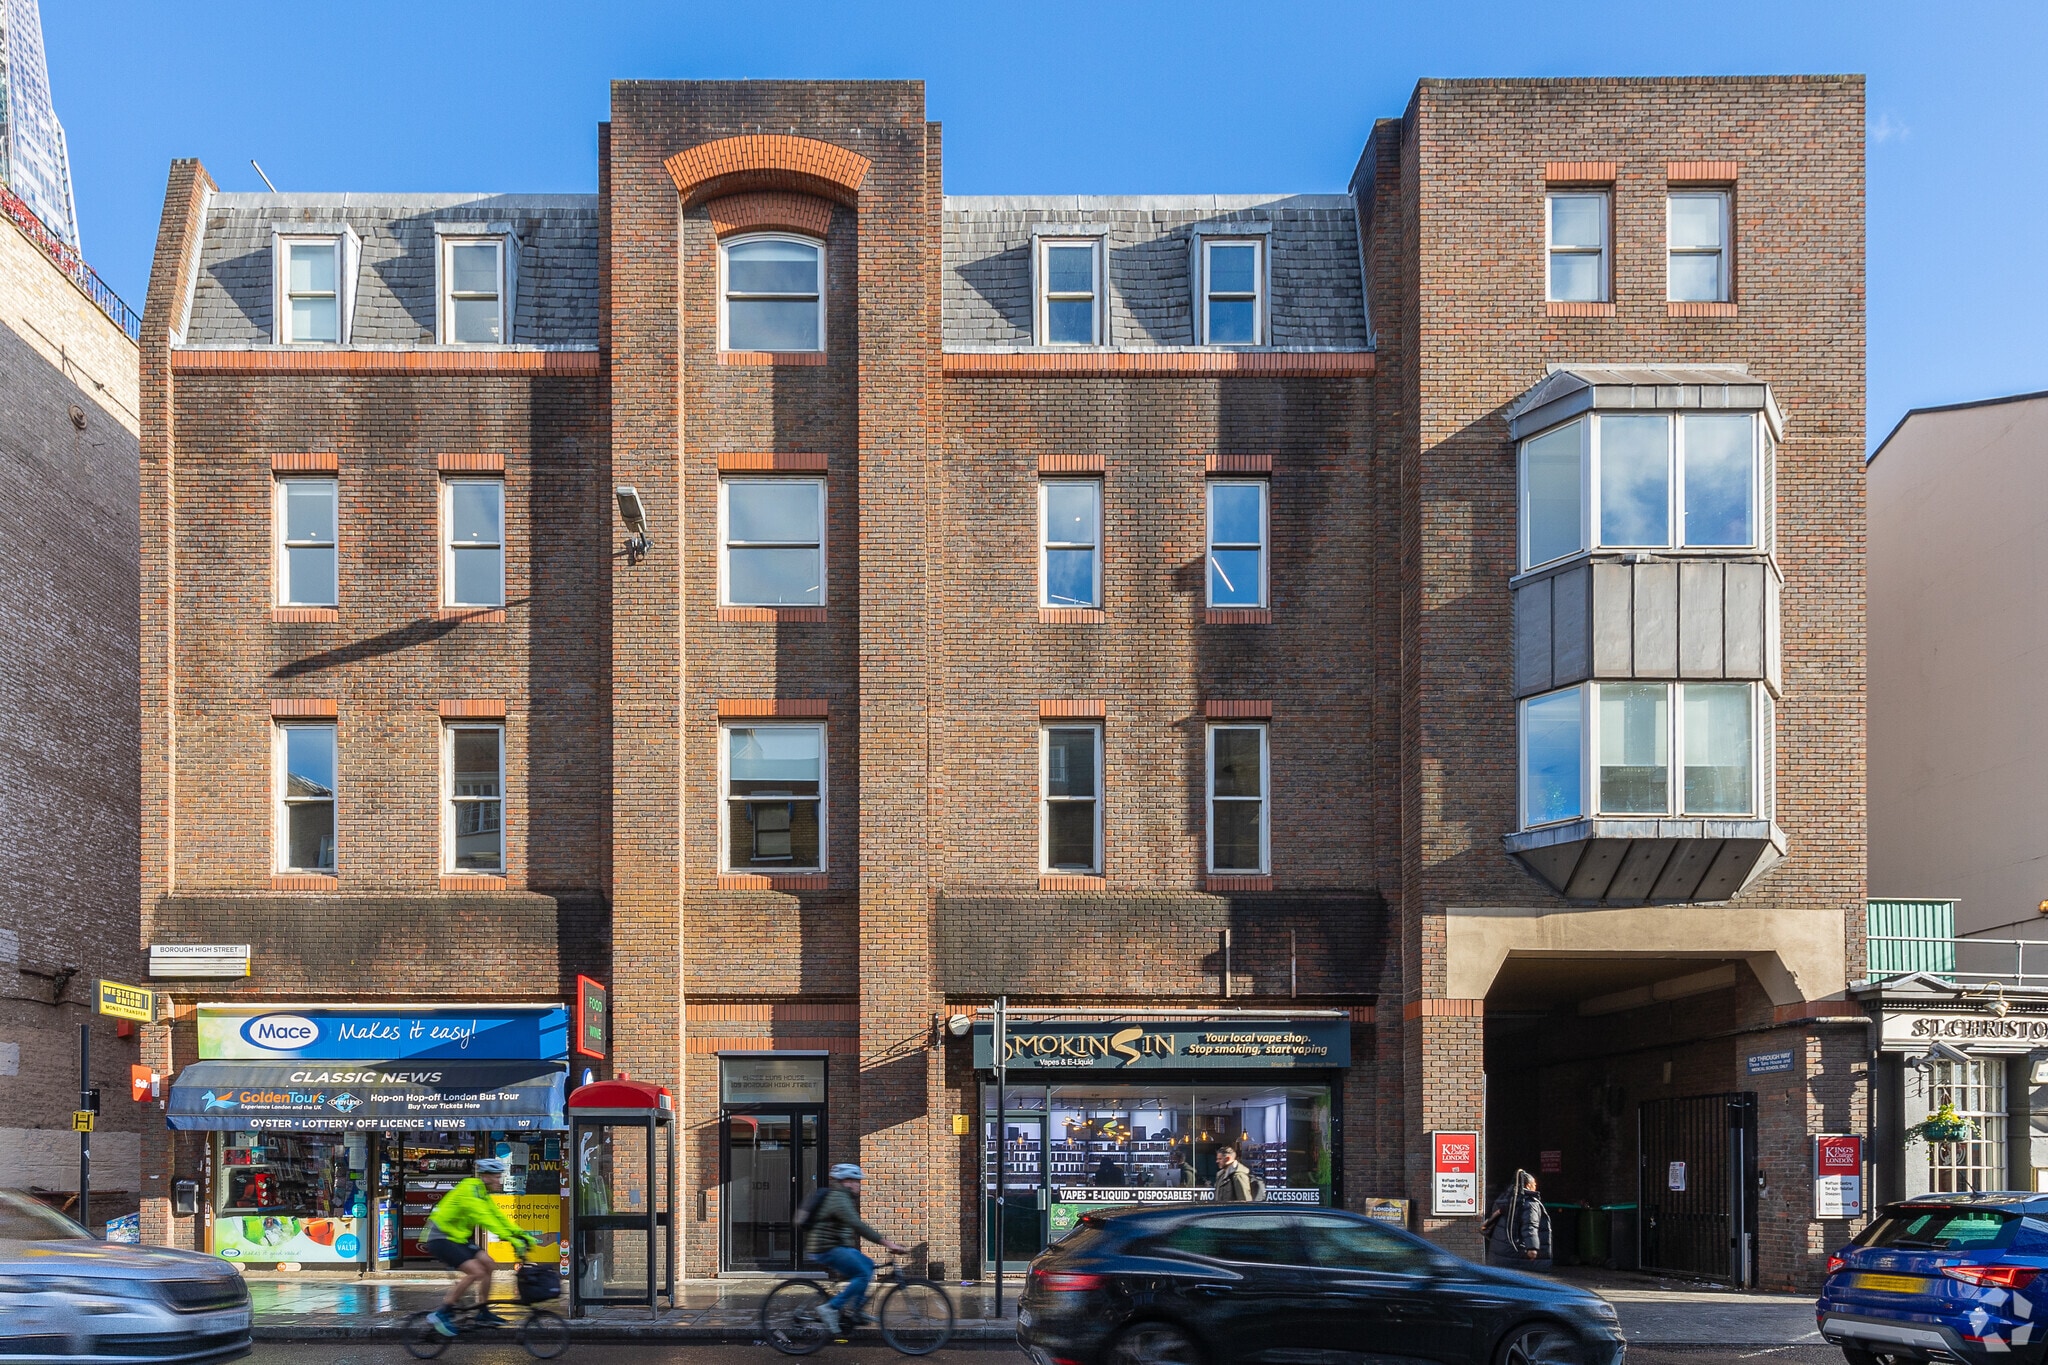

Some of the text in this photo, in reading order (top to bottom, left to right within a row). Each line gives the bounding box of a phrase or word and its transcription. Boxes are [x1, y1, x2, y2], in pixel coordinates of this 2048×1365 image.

[103, 986, 142, 1000] WESTERN
[116, 996, 142, 1008] UNION
[588, 997, 603, 1012] FOOD
[105, 1004, 147, 1017] MONEY TRANSFER
[258, 1019, 477, 1050] Mace Makes it easy!
[589, 1025, 602, 1040] WINE
[1205, 1033, 1311, 1045] Your local vape shop.
[1189, 1044, 1328, 1056] Stop smoking, start vaping
[1039, 1059, 1060, 1067] Vapes
[1067, 1059, 1094, 1067] E-Liquid
[1757, 1054, 1779, 1062] THROUGH
[290, 1071, 443, 1083] CLASSIC NEWS
[370, 1093, 519, 1102] Hop-on Hop-off London Bus Tour
[76, 1113, 90, 1129] H
[250, 1119, 466, 1128] OYSTER LOTTERY OFF LICENCE NEWS
[1442, 1144, 1470, 1155] KING'S
[1825, 1147, 1854, 1158] KING'S
[752, 1182, 770, 1190] 109
[1060, 1191, 1087, 1200] VAPES
[1093, 1191, 1130, 1200] E-LIQUID
[1138, 1191, 1192, 1200] DISPOSABLES
[1267, 1191, 1320, 1201] ACCESSORIES
[337, 1244, 358, 1252] VALUE
